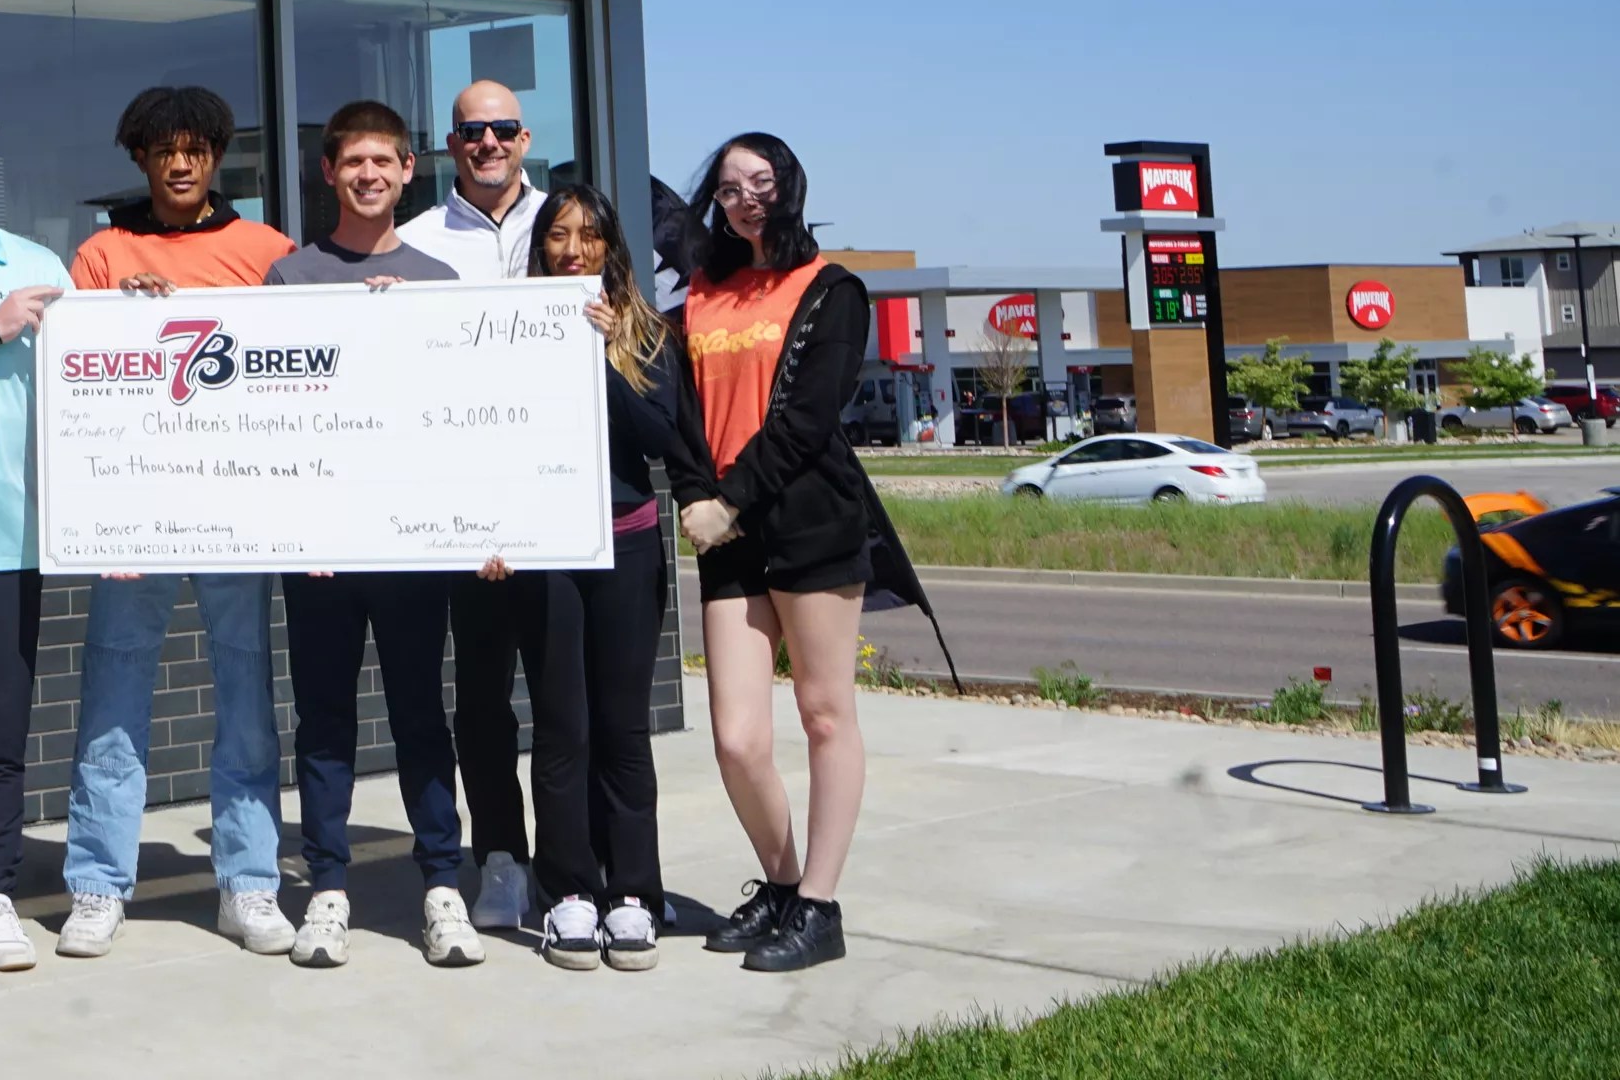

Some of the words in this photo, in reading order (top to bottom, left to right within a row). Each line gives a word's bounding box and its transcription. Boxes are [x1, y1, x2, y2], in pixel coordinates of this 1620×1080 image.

[1142, 167, 1194, 199] MAVERIK
[545, 304, 577, 317] 1001
[1352, 290, 1391, 317] MAVERIK
[460, 310, 565, 347] 5/14/2025
[61, 350, 165, 380] SEVEN
[243, 345, 340, 377] BREW
[72, 387, 113, 397] DRIVE
[119, 386, 154, 396] THRU
[247, 384, 300, 394] COFFEE
[142, 411, 230, 436] Children's
[238, 413, 303, 437] Hospital
[313, 412, 384, 434] Colorado
[422, 410, 433, 428] $
[443, 405, 529, 428] 2,000.00
[84, 455, 120, 478] Two
[125, 454, 204, 477] thousand
[212, 459, 261, 477] dollars
[270, 462, 300, 478] and
[95, 522, 143, 537] Denver
[155, 520, 234, 539] Ribbon-Cutting
[390, 515, 446, 535] Seven
[453, 515, 500, 534] Brew
